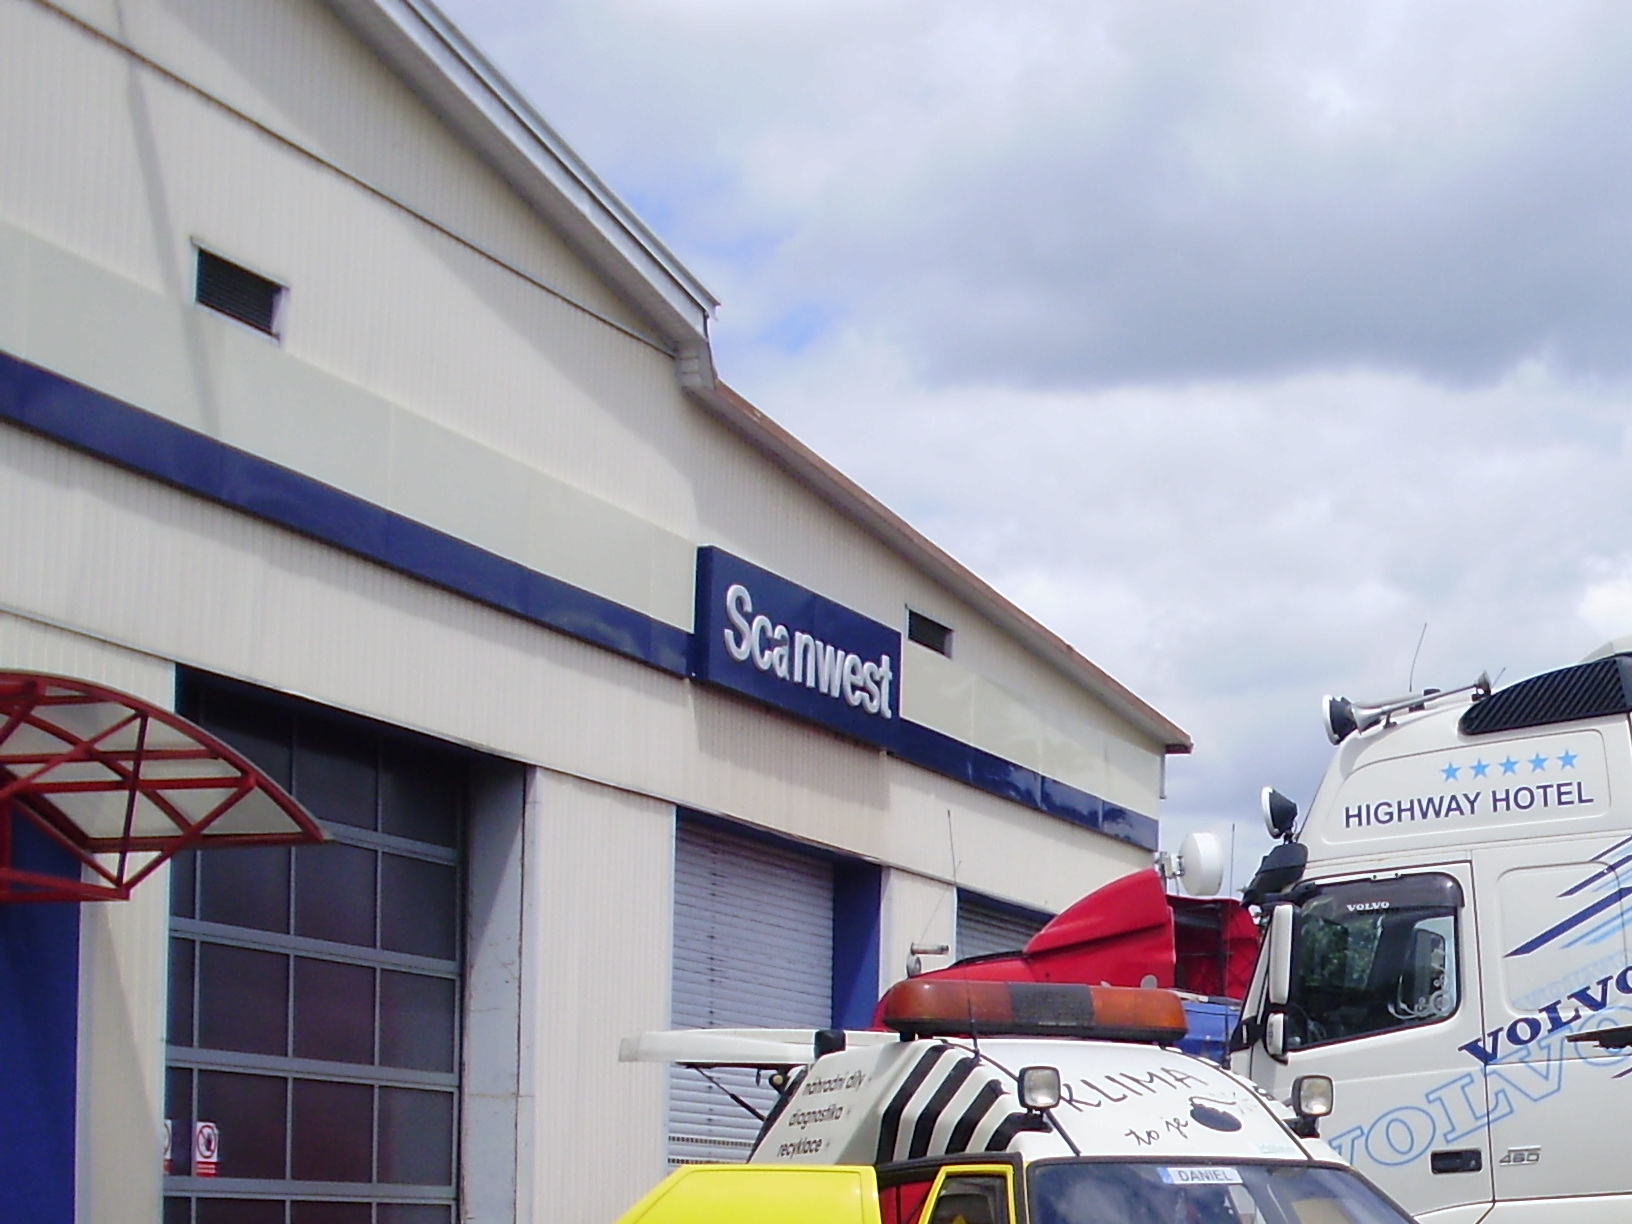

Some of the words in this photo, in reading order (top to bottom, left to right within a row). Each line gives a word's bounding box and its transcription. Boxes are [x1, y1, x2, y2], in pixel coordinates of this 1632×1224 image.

[724, 584, 893, 719] Scanwest
[1344, 791, 1482, 828] HIGHWAY
[1491, 781, 1594, 813] HOTEL
[1346, 901, 1390, 912] VOLVO
[1060, 1067, 1208, 1112] KLIMA
[788, 1103, 844, 1130] diagnostika
[777, 1136, 823, 1159] recyklace
[1177, 1169, 1234, 1182] DANIEL
